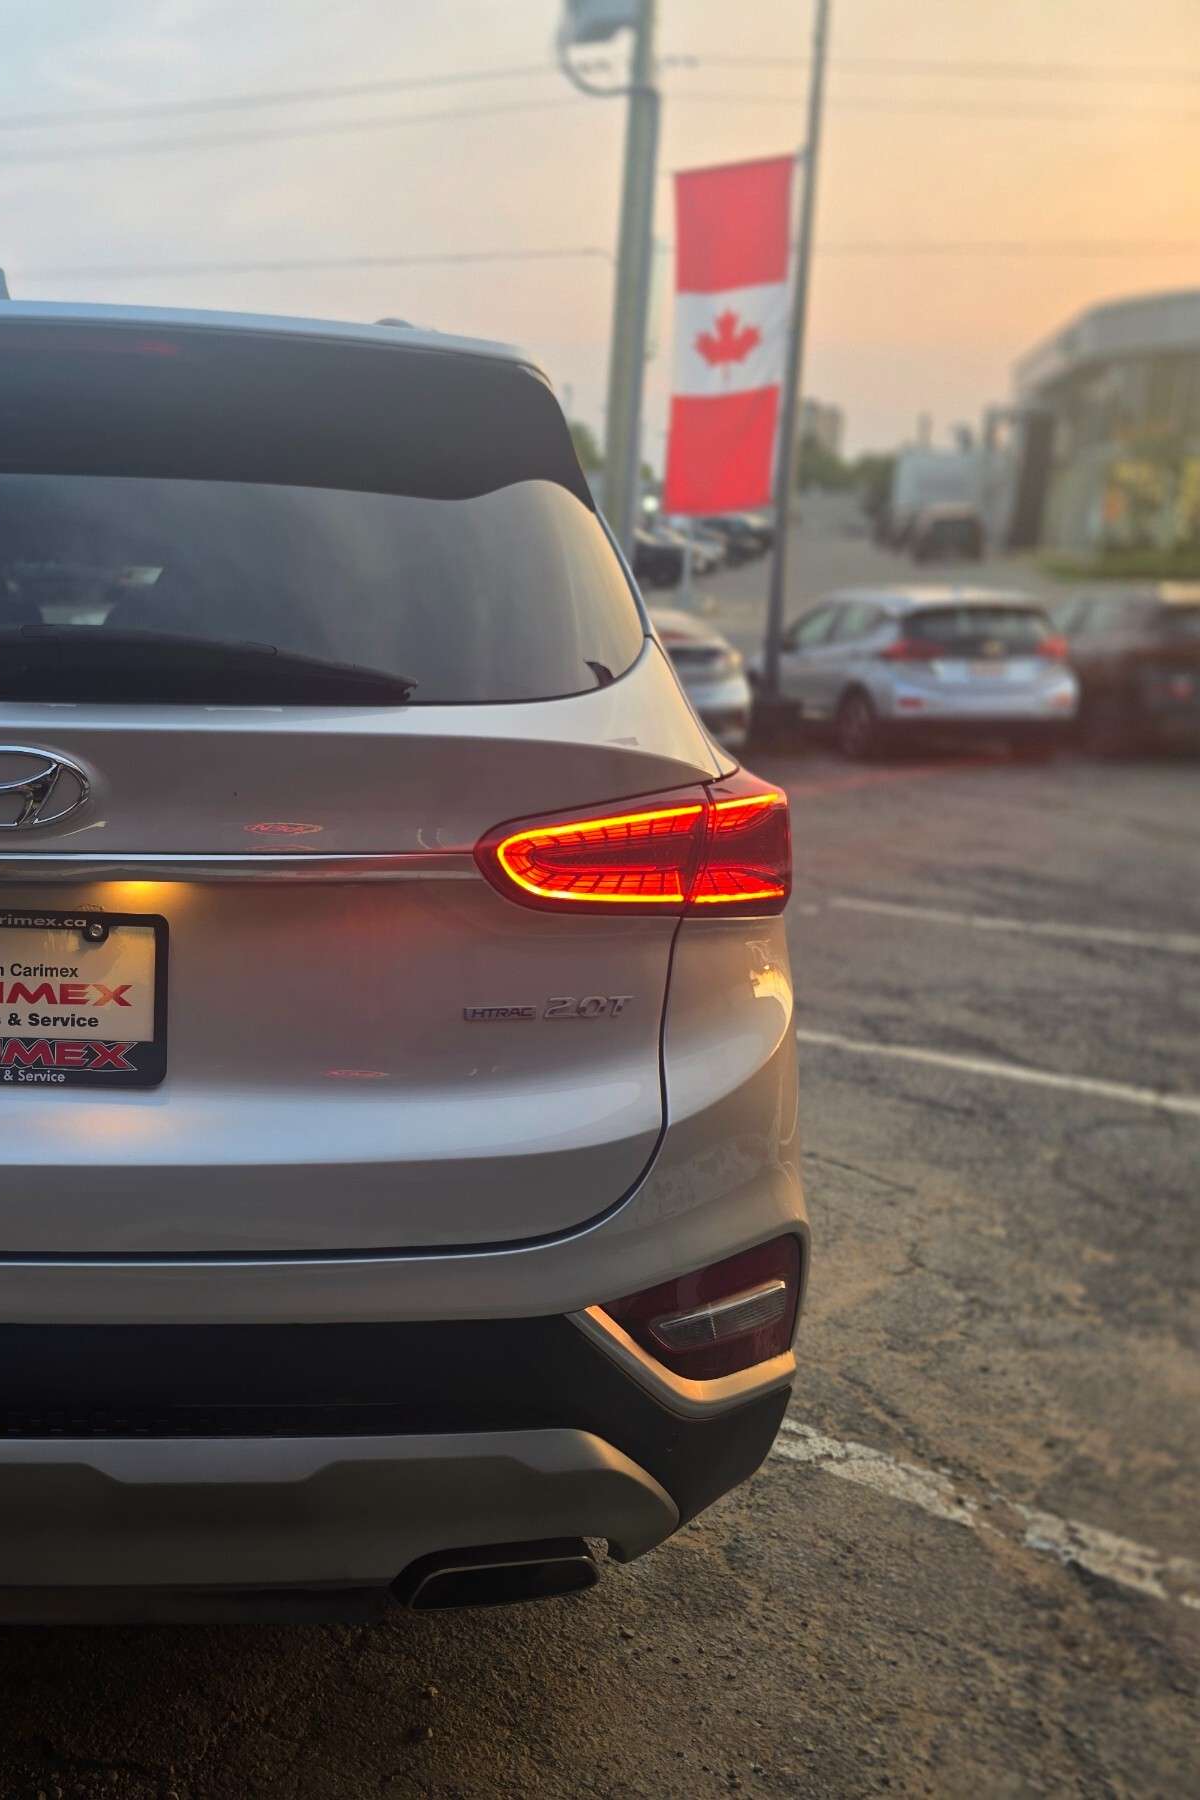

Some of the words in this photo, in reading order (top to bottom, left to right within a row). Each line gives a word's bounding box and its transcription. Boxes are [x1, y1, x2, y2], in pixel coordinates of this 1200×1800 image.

[10, 964, 78, 978] Carimex
[472, 1007, 533, 1018] HTRAC
[7, 1013, 22, 1027] &
[28, 1014, 99, 1028] Service
[4, 1070, 14, 1082] &
[18, 1070, 66, 1083] Service
